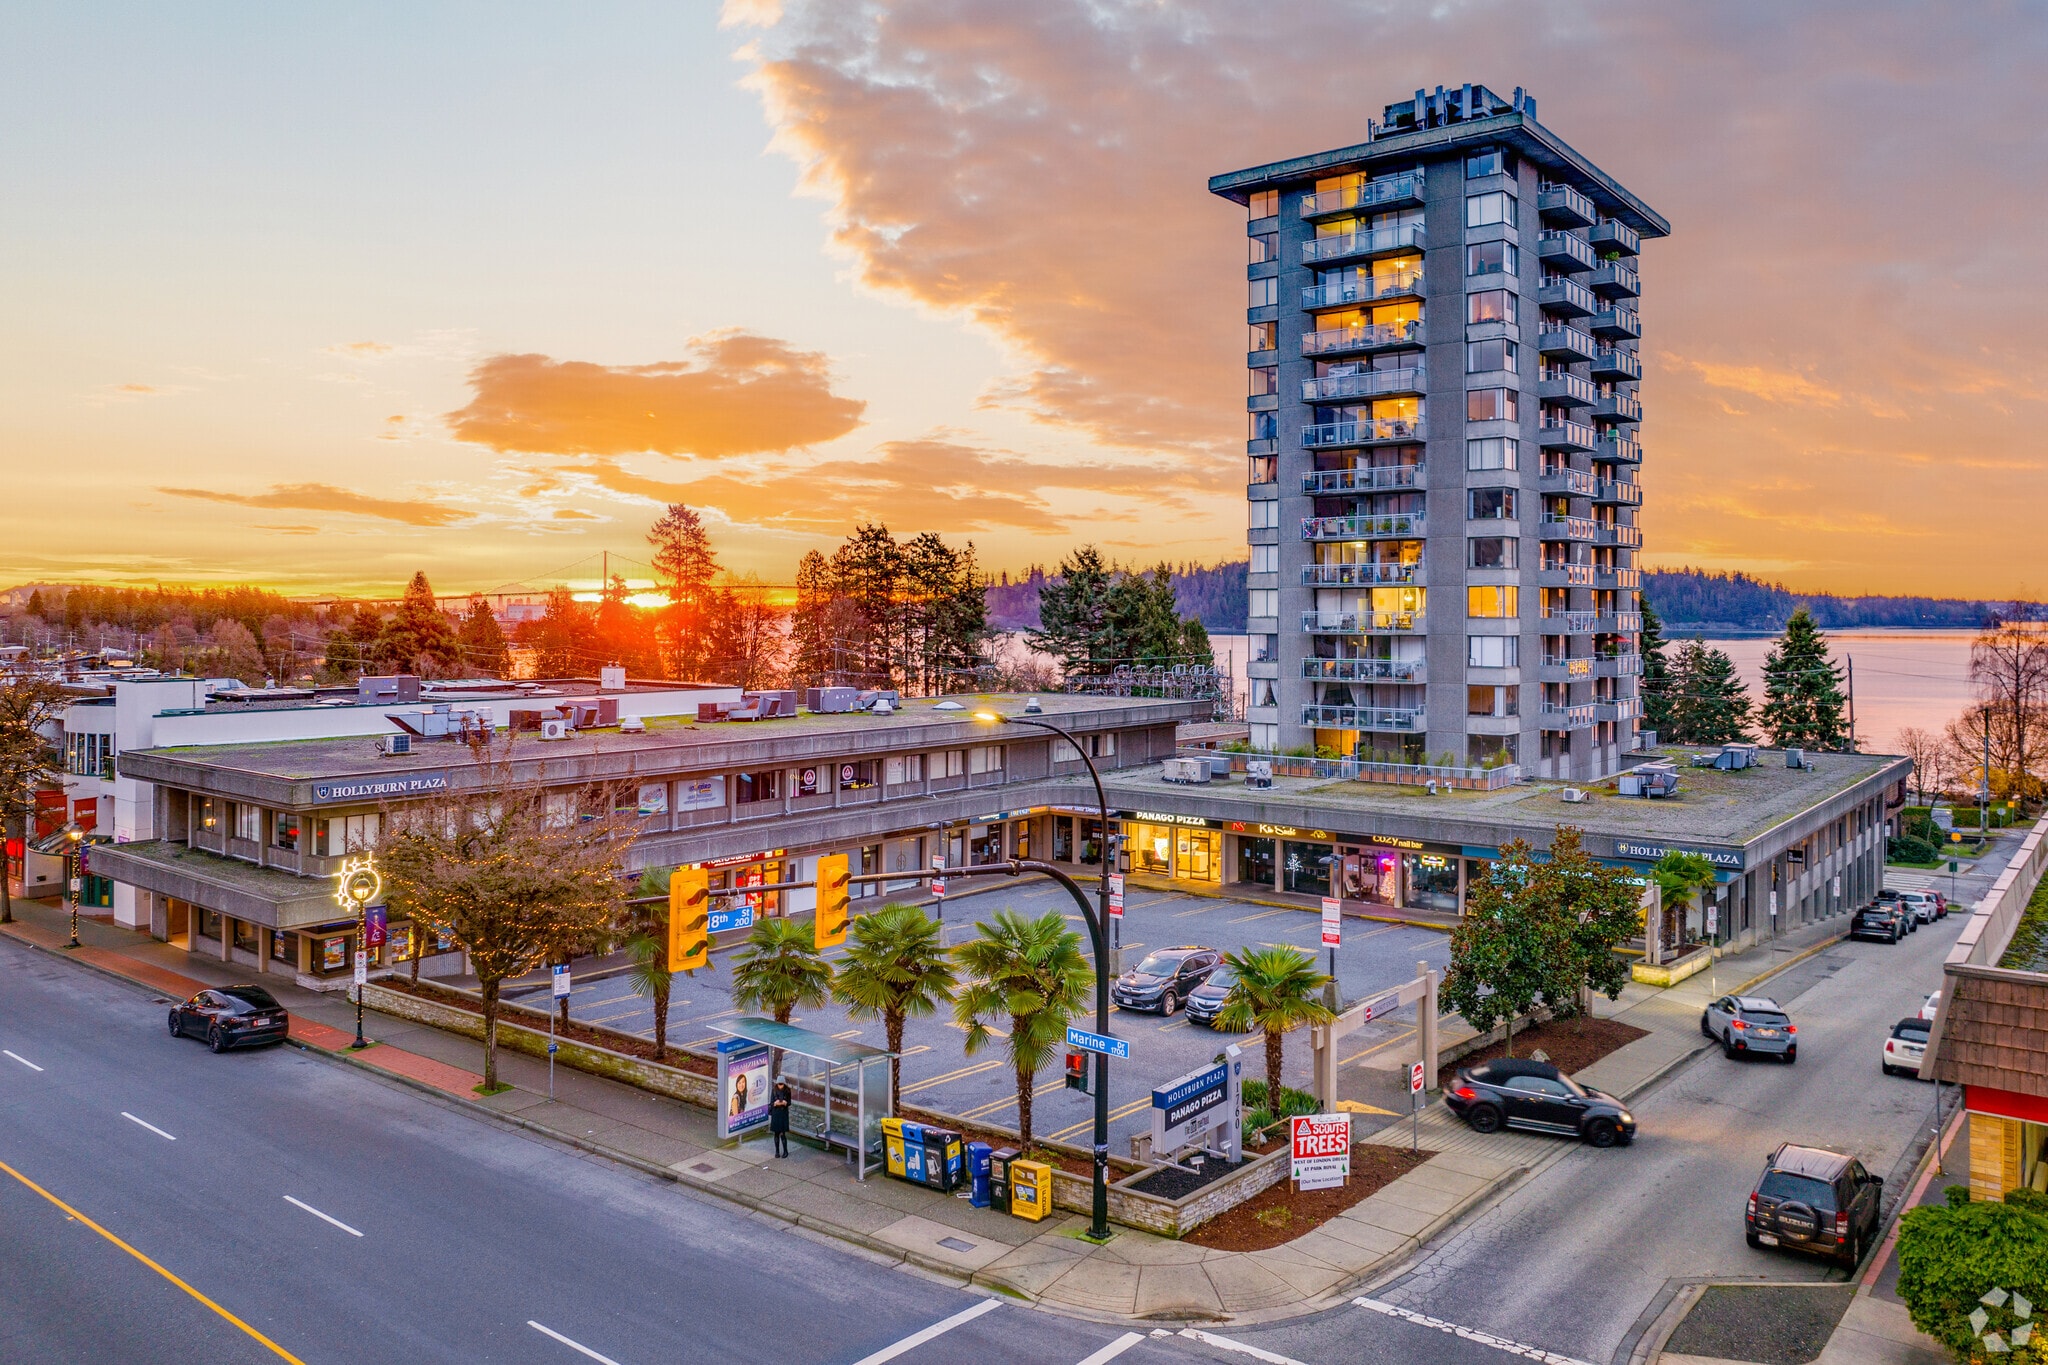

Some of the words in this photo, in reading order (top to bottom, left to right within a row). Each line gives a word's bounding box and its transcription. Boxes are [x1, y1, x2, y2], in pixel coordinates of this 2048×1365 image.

[332, 781, 407, 798] HOLLYBURN
[410, 778, 447, 790] PLAZA
[1136, 811, 1175, 823] PANAGO
[1176, 815, 1206, 826] PIZZA
[1701, 852, 1740, 865] PLAZA
[741, 908, 750, 918] St
[734, 917, 750, 928] 200
[1070, 1031, 1106, 1050] Marine
[1117, 1041, 1126, 1050] Dr
[1110, 1046, 1125, 1057] 1700
[1168, 1078, 1204, 1104] HOLLYBURN
[1206, 1069, 1225, 1085] PLAZA
[1170, 1101, 1200, 1123] PANAGO
[1201, 1088, 1222, 1107] PIZZA
[1313, 1122, 1346, 1134] SCOUTS
[1297, 1134, 1347, 1155] TREES
[1778, 1216, 1814, 1229] SUZUKI
